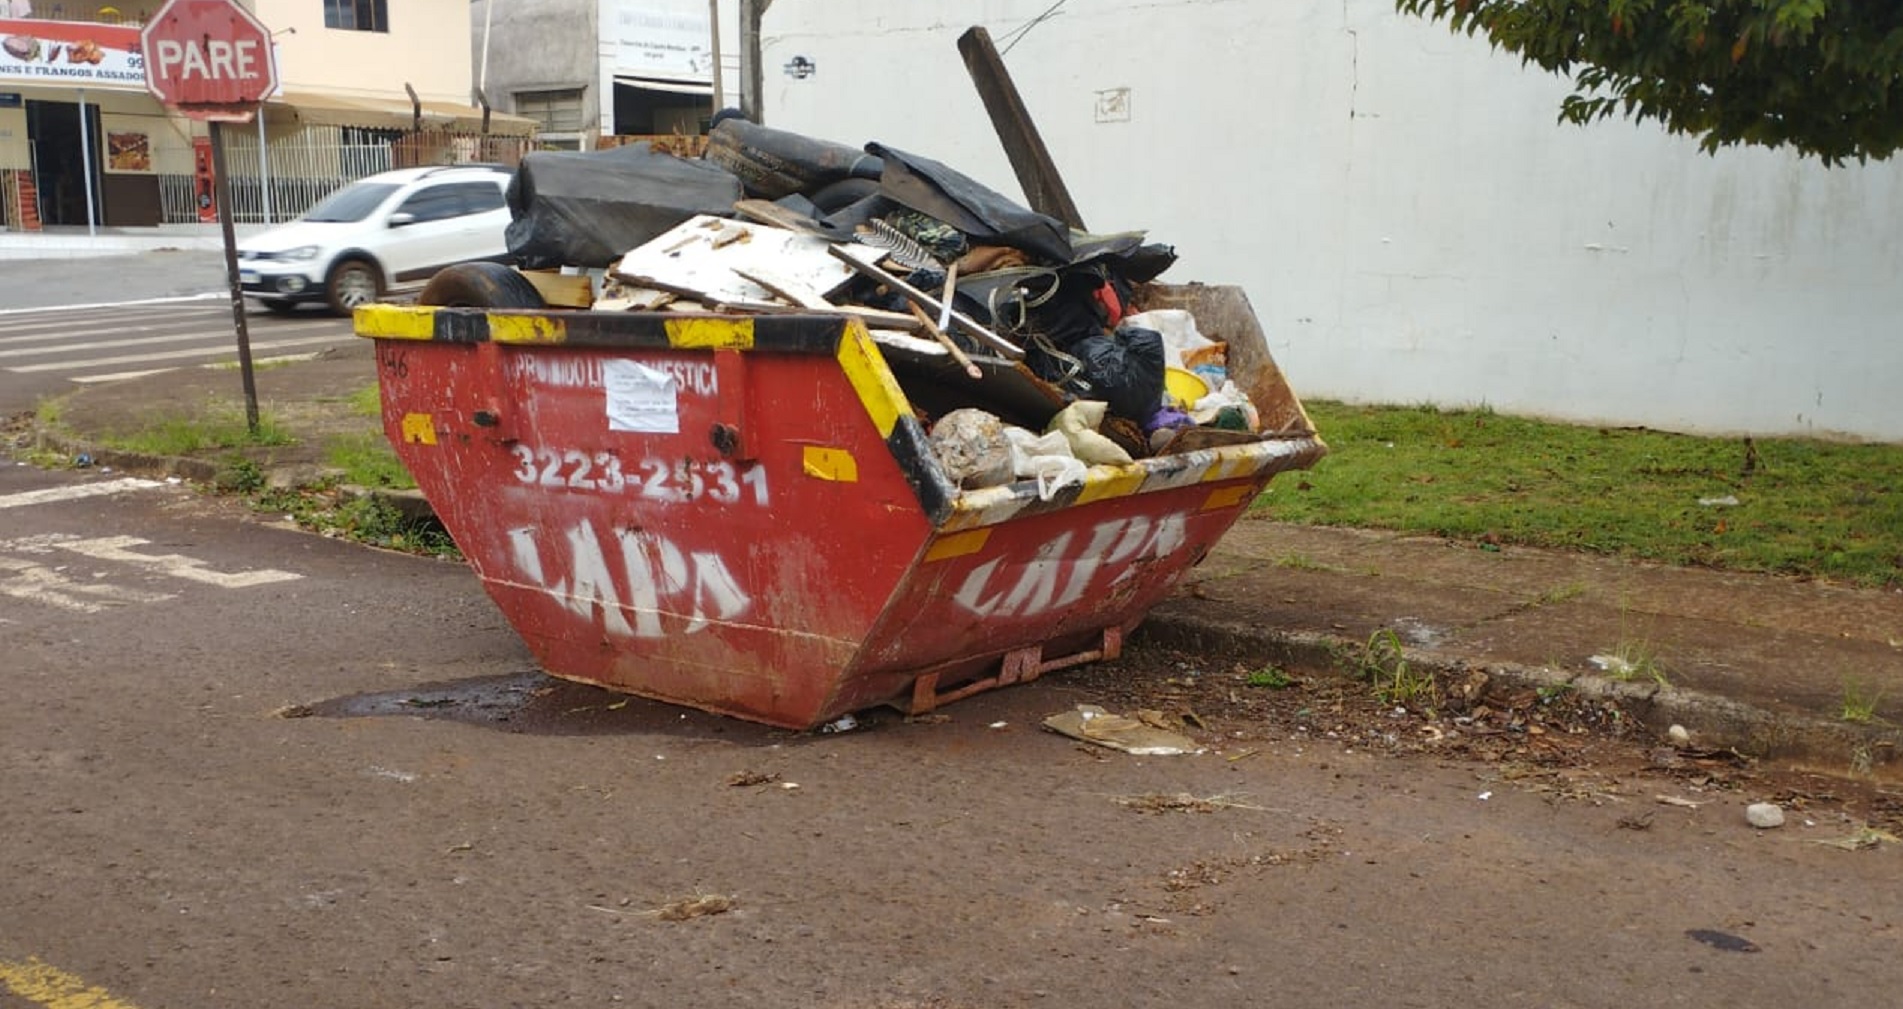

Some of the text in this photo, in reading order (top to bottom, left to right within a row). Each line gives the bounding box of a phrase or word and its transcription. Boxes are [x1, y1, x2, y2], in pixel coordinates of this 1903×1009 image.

[36, 66, 92, 77] FRANGOS
[155, 39, 259, 80] PARE
[510, 444, 770, 507] 3223-2531
[507, 517, 751, 638] LAPA
